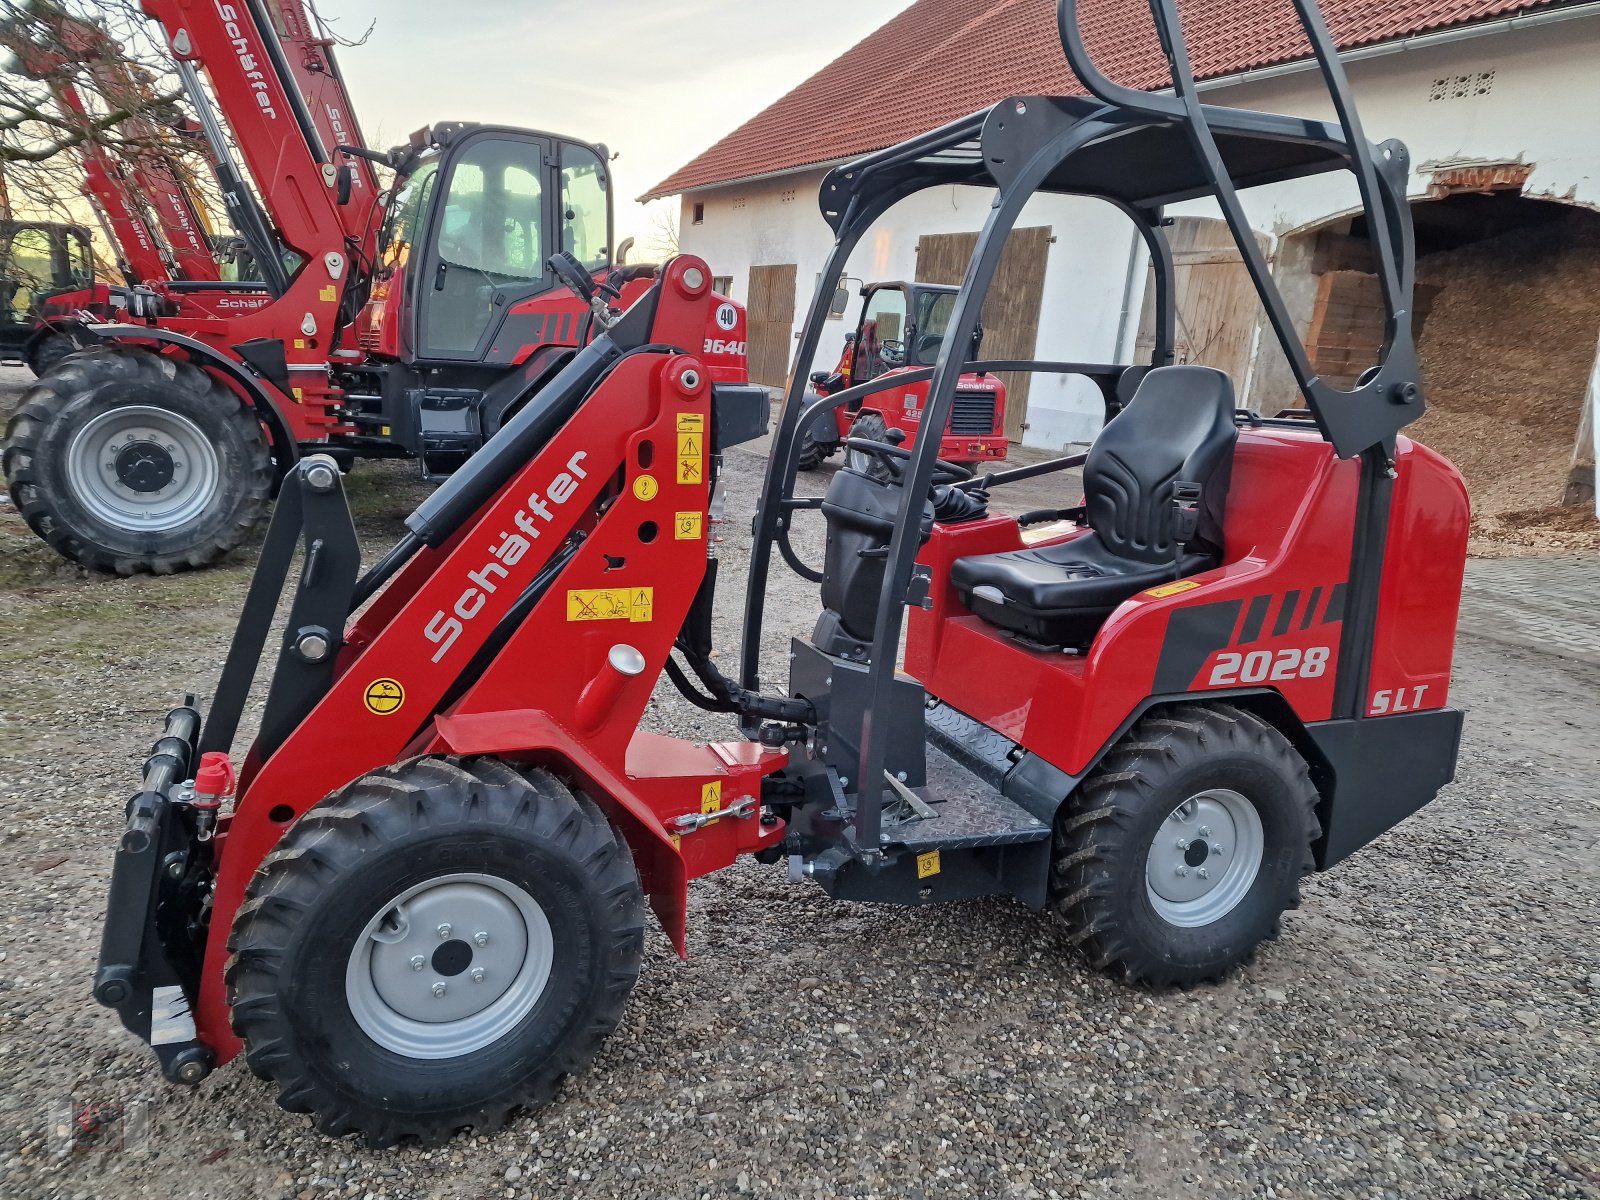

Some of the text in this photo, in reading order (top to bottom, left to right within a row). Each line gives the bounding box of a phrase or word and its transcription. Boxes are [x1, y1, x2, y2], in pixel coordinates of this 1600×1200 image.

[214, 0, 276, 119] Schäffer
[326, 103, 362, 188] Schfer
[720, 308, 734, 326] 40
[703, 338, 747, 356] 9640
[423, 450, 588, 664] Schäffer
[1208, 646, 1331, 686] 2028
[1369, 684, 1429, 715] SLT
